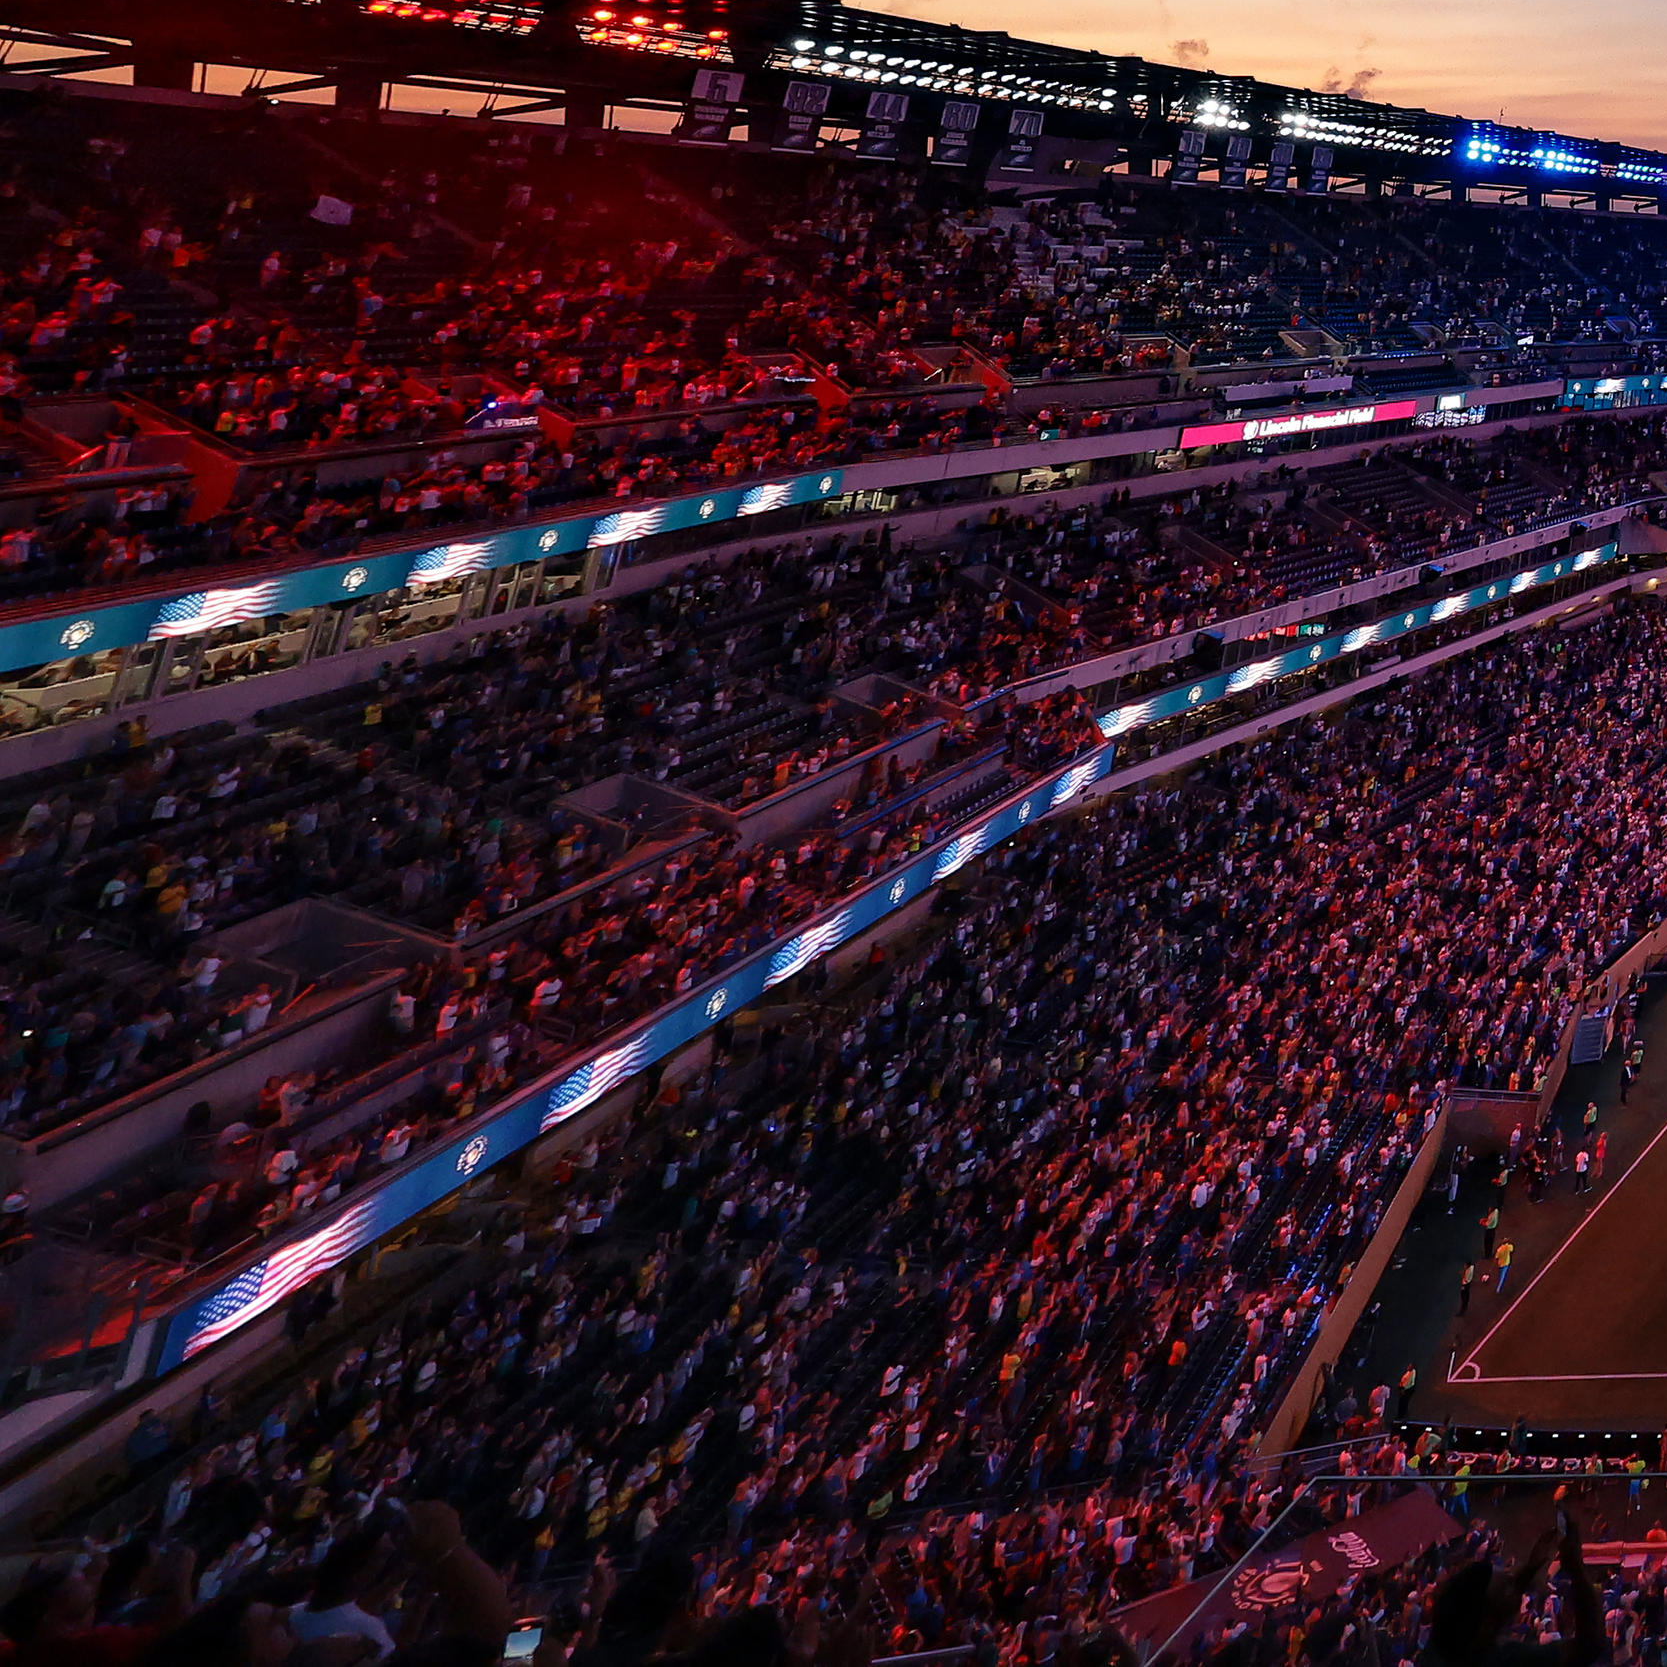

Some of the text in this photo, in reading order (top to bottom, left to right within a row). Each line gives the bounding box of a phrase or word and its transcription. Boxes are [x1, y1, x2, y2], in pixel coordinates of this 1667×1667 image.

[707, 73, 730, 103] 5
[1259, 406, 1375, 436] Lincoln Financial Field
